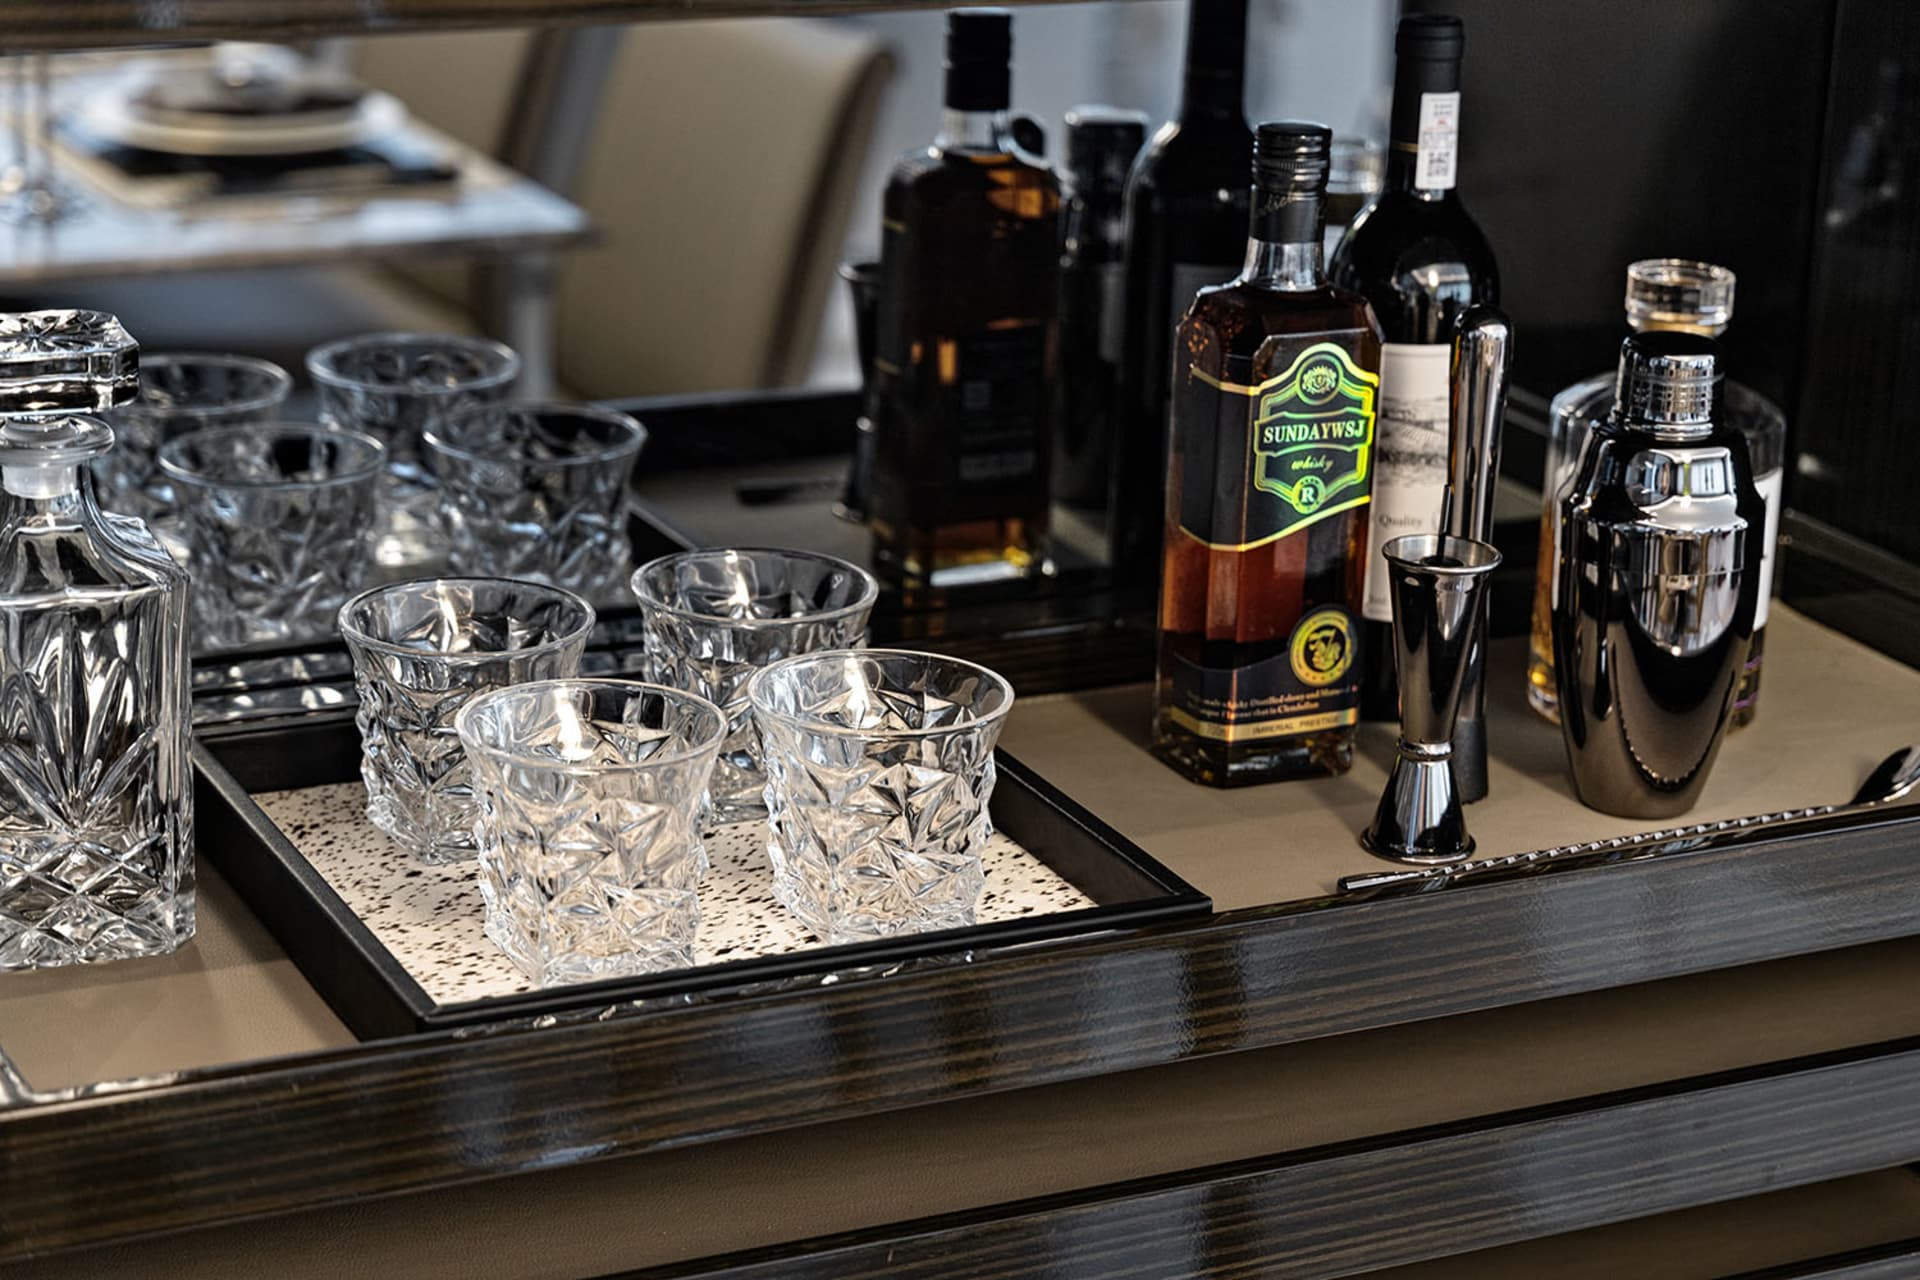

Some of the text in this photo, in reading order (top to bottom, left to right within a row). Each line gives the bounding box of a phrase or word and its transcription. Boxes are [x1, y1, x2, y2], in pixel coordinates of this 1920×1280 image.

[1263, 420, 1366, 443] SUNDAYWSJ
[1291, 454, 1334, 473] whisky
[1301, 486, 1315, 503] R
